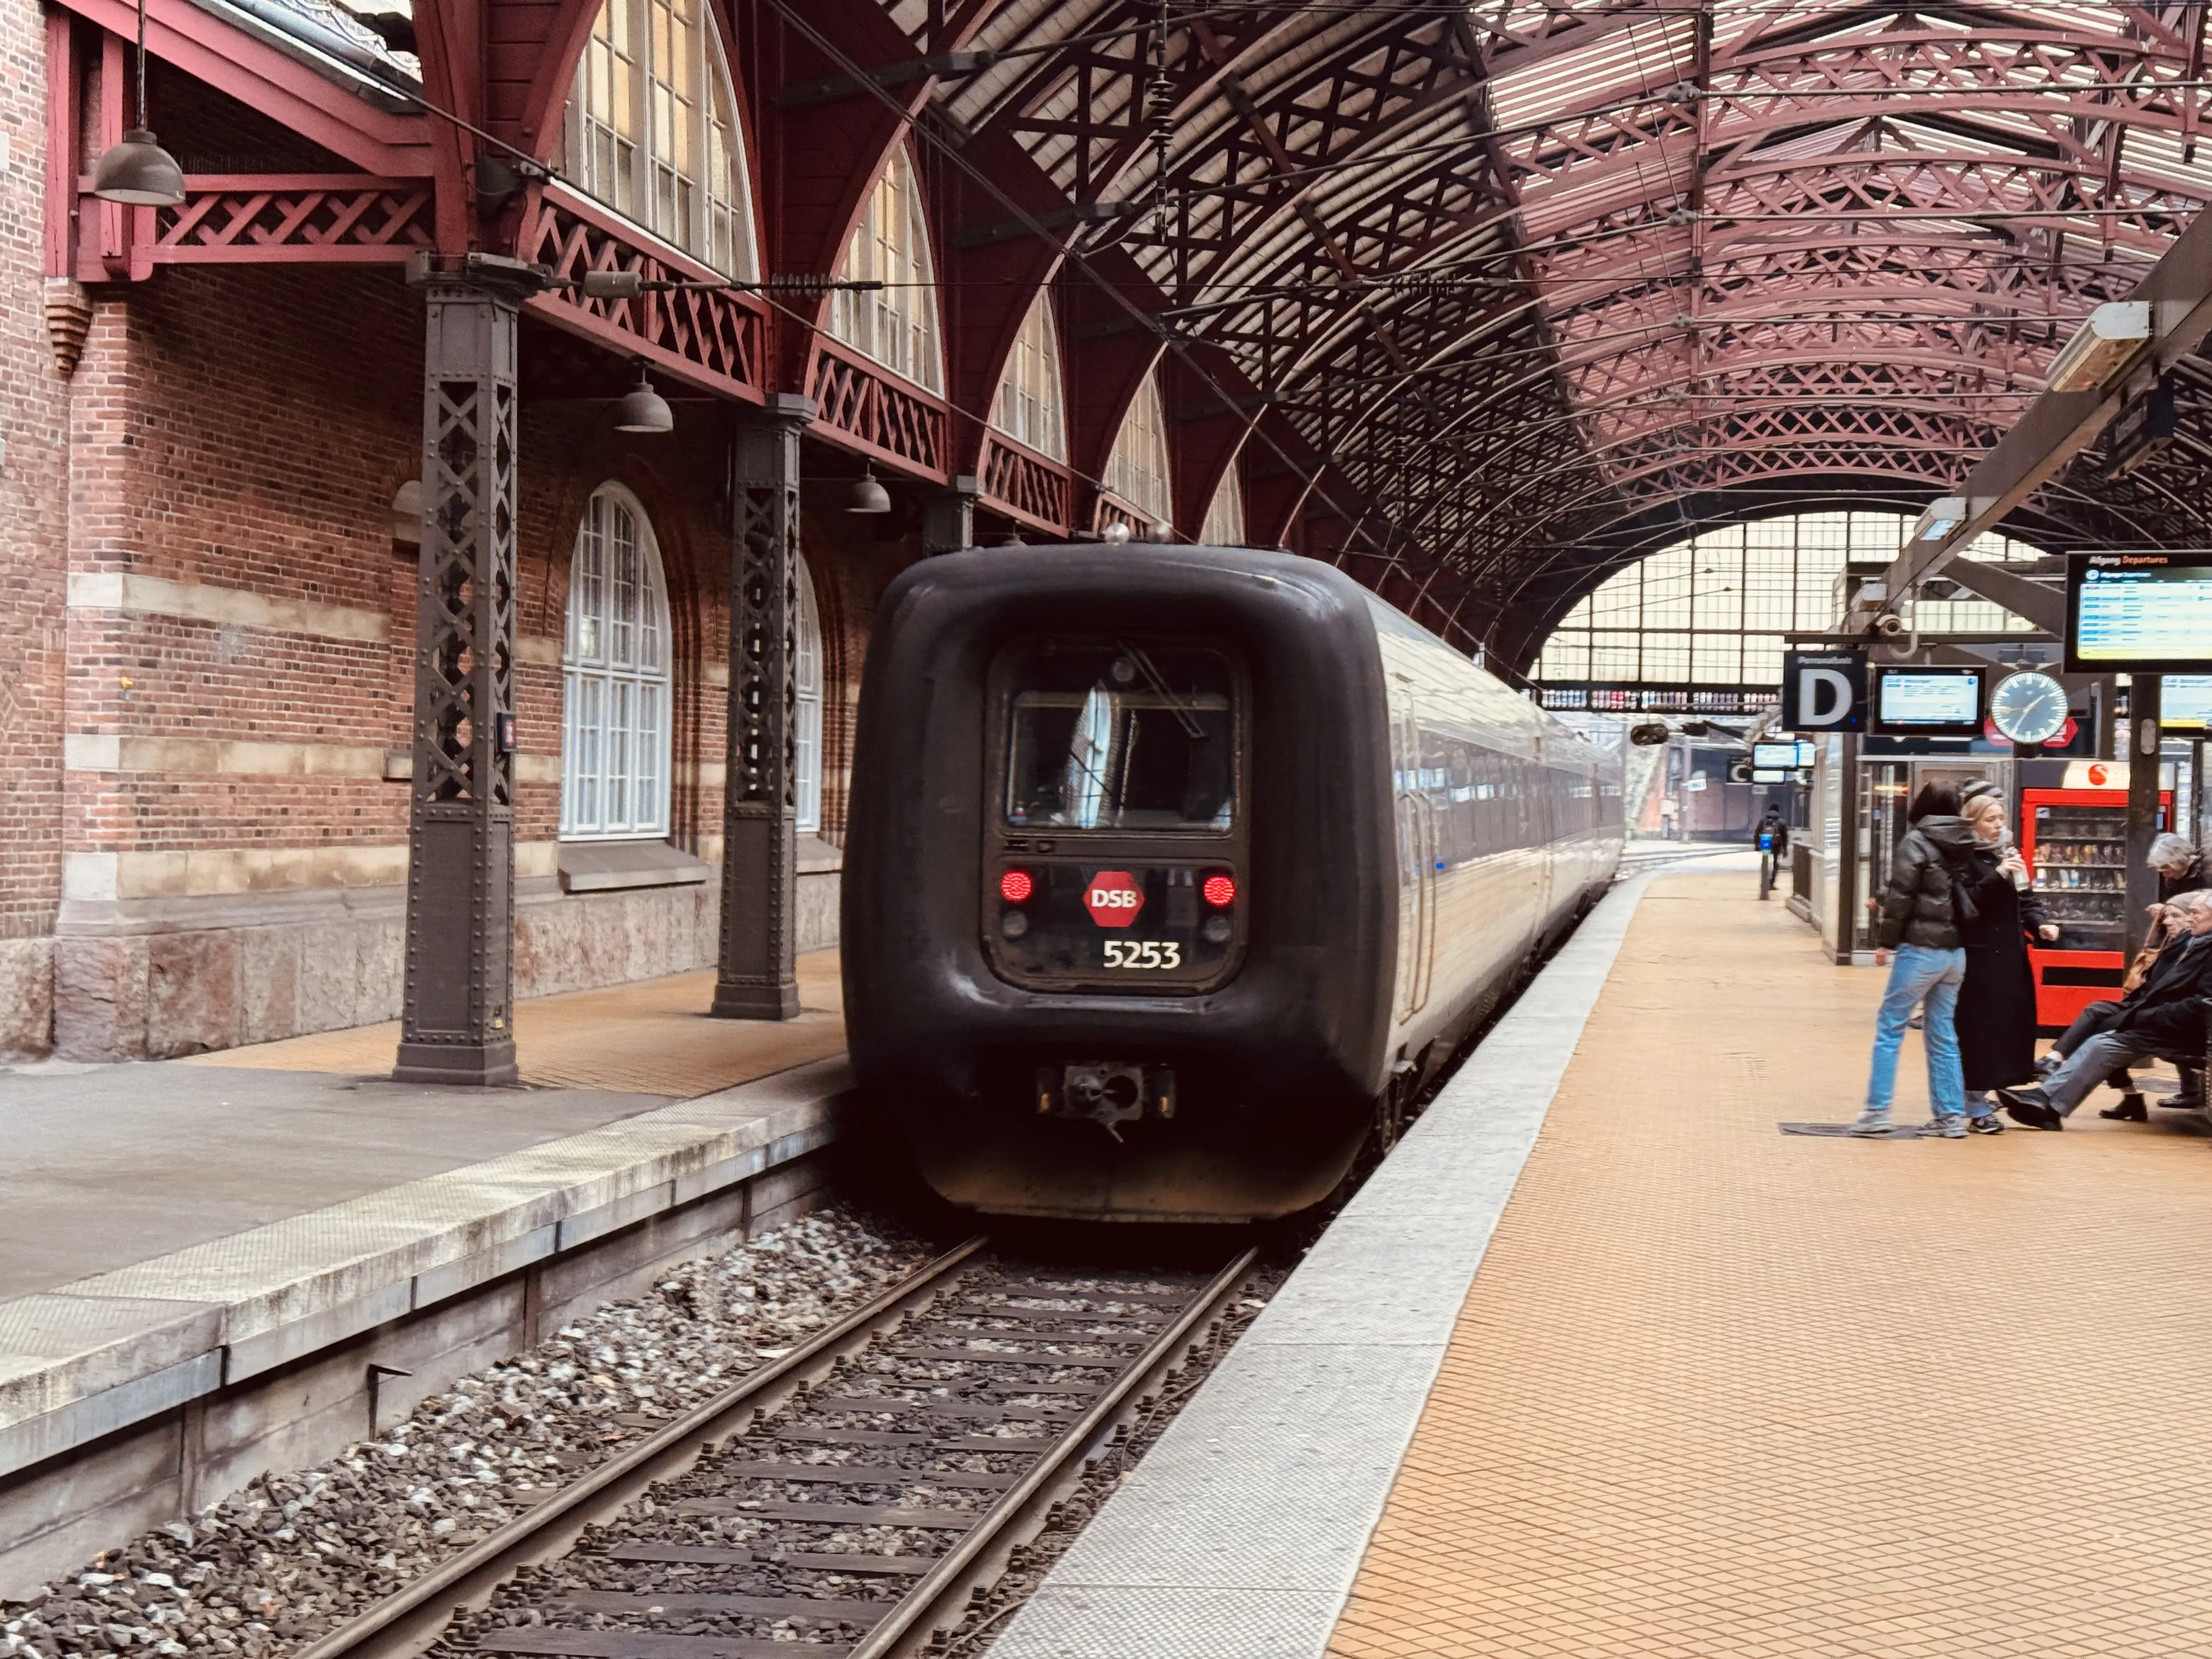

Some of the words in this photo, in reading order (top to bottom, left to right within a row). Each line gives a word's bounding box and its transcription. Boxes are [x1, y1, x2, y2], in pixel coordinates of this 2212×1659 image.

[2122, 555, 2168, 565] Departures
[1799, 669, 1852, 725] D
[1091, 889, 1137, 908] DSB
[1103, 940, 1181, 969] 5253
